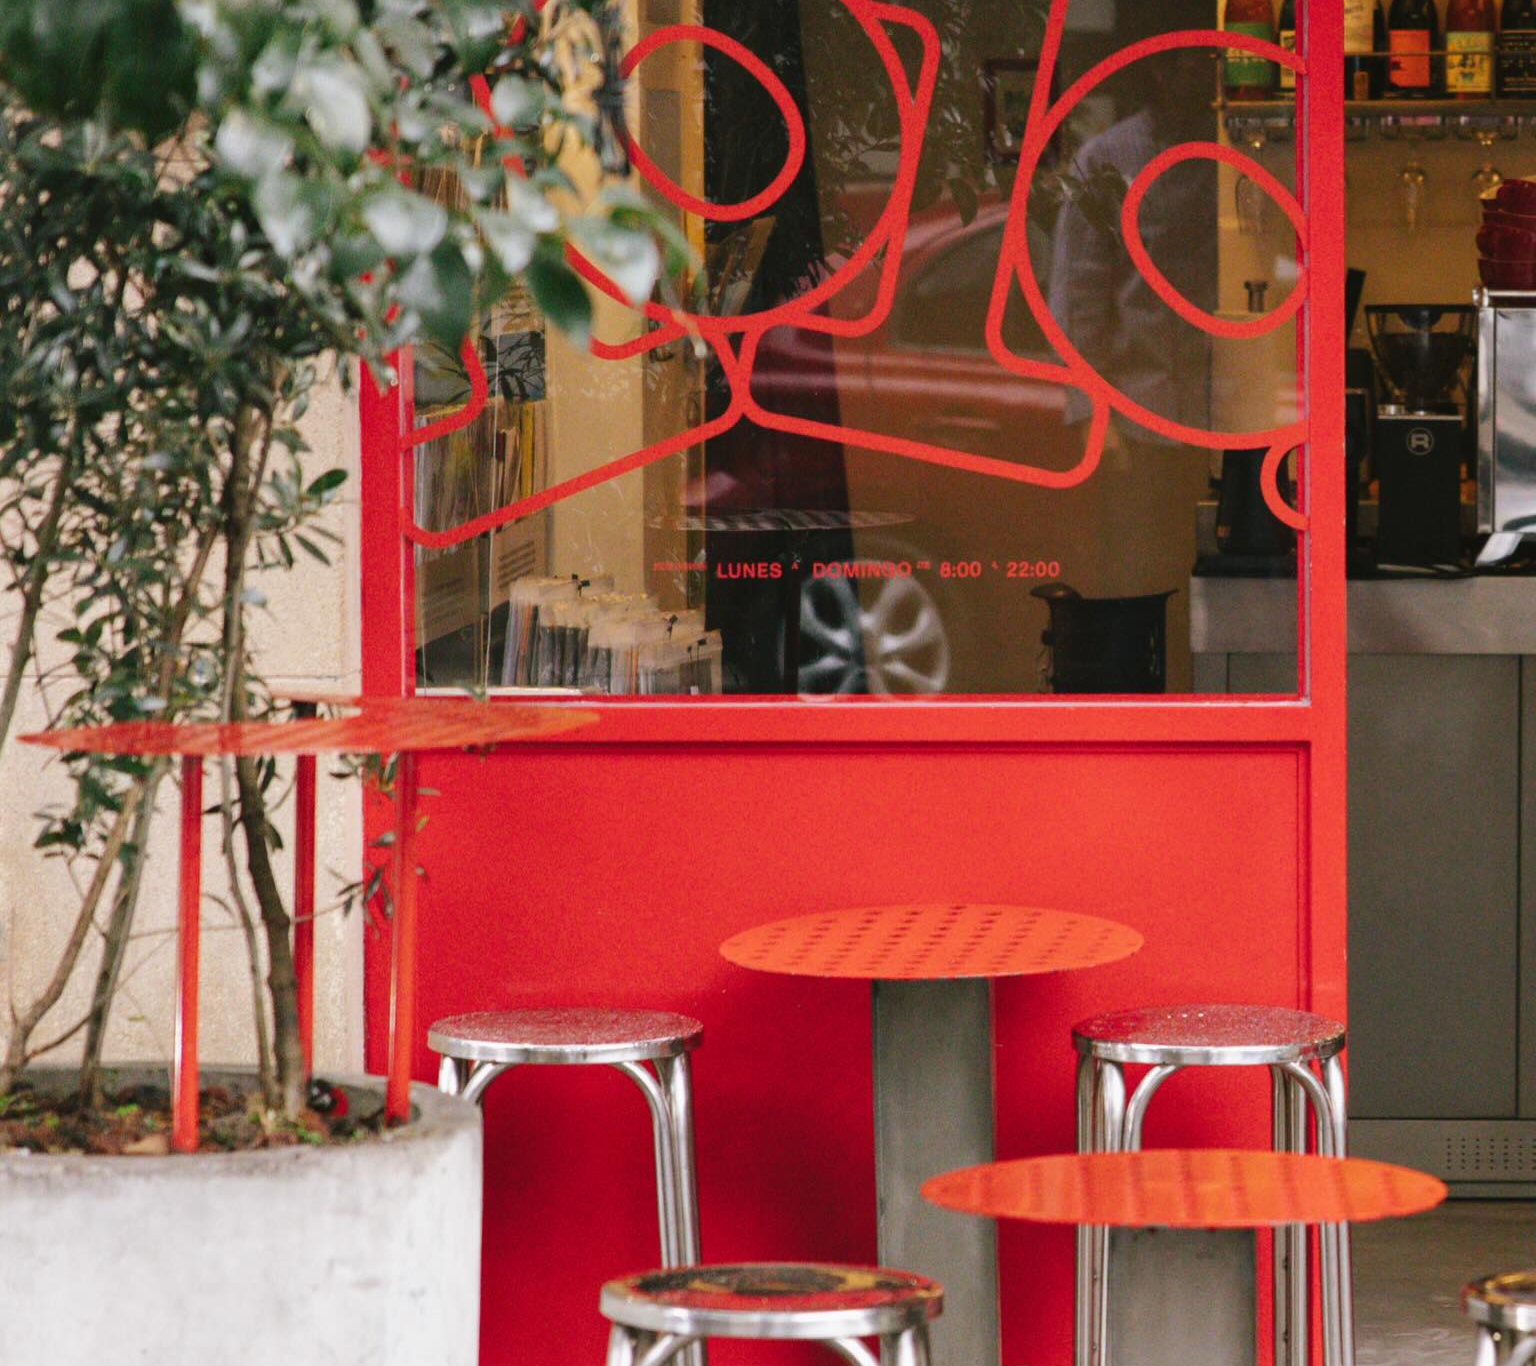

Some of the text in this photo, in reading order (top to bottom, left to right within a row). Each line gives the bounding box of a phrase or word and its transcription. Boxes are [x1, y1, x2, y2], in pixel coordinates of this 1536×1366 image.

[716, 562, 783, 579] LUNES
[812, 560, 913, 579] DOMINGO
[939, 560, 982, 579] 8:00
[1006, 560, 1061, 579] 22:00
